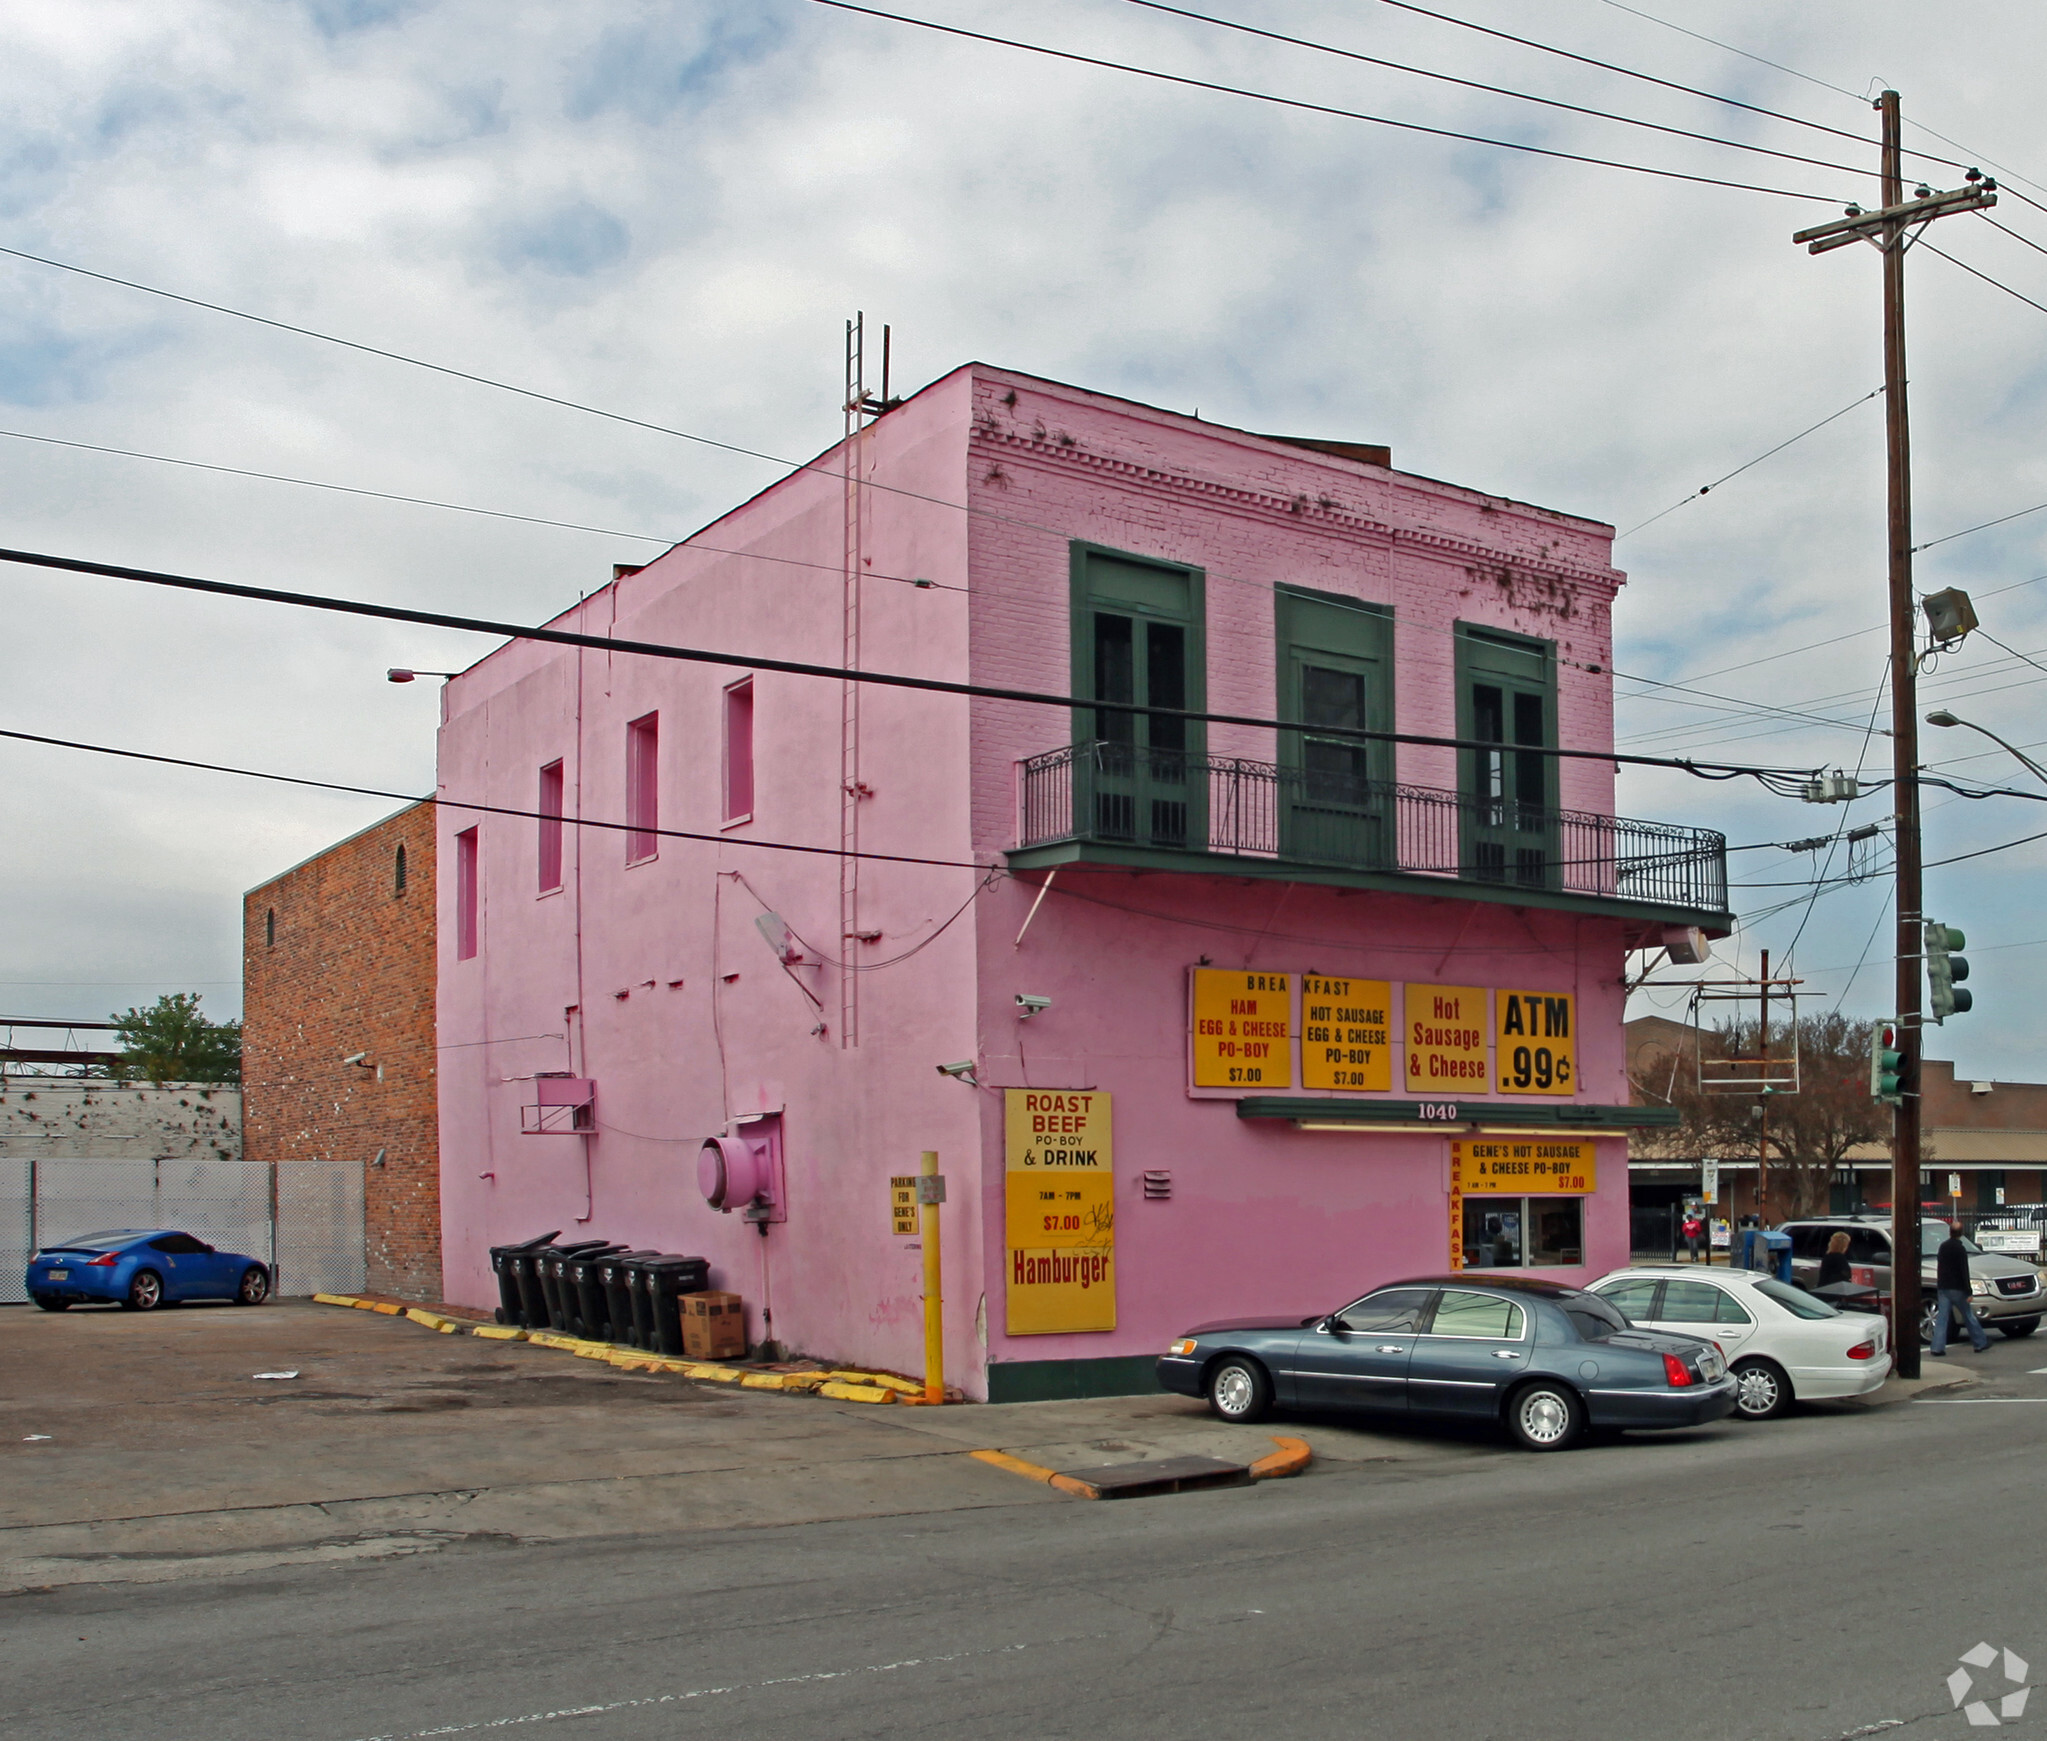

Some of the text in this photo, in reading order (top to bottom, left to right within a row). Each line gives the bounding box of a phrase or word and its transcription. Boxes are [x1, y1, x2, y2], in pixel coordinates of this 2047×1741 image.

[1230, 1000, 1257, 1015] HAM
[1310, 1006, 1385, 1025] HOT SAUSAGE
[1433, 996, 1460, 1021] Hot
[1504, 995, 1569, 1038] ATM
[1199, 1020, 1287, 1038] EGG & CHEESE
[1307, 1027, 1386, 1045] EGG & CHEESE
[1413, 1022, 1480, 1051] Sausage
[1218, 1042, 1269, 1058] PO-BOY
[1325, 1049, 1371, 1065] PO-BOY
[1409, 1054, 1485, 1079] & Cheese
[1229, 1067, 1262, 1083] $7.00
[1333, 1071, 1364, 1086] $7.00
[1026, 1095, 1092, 1113] ROAST
[1418, 1104, 1457, 1120] 1040
[1033, 1115, 1086, 1133] BEEF
[1036, 1136, 1083, 1146] PO-BOY
[1024, 1149, 1098, 1166] & DRINK
[1473, 1145, 1580, 1158] GENE'S HOT SAUSAGE
[1479, 1162, 1571, 1174] & CHEESE PO-BOY
[1558, 1176, 1584, 1188] $7.00
[898, 1192, 909, 1202] FOR
[1039, 1192, 1054, 1200] 7AM
[1066, 1192, 1081, 1201] 7PM
[894, 1207, 915, 1217] GENE'S
[1451, 1143, 1460, 1268] BREAKFAST
[898, 1222, 912, 1232] ONLY
[1044, 1215, 1080, 1231] $7.00
[1014, 1250, 1109, 1289] Hamburger
